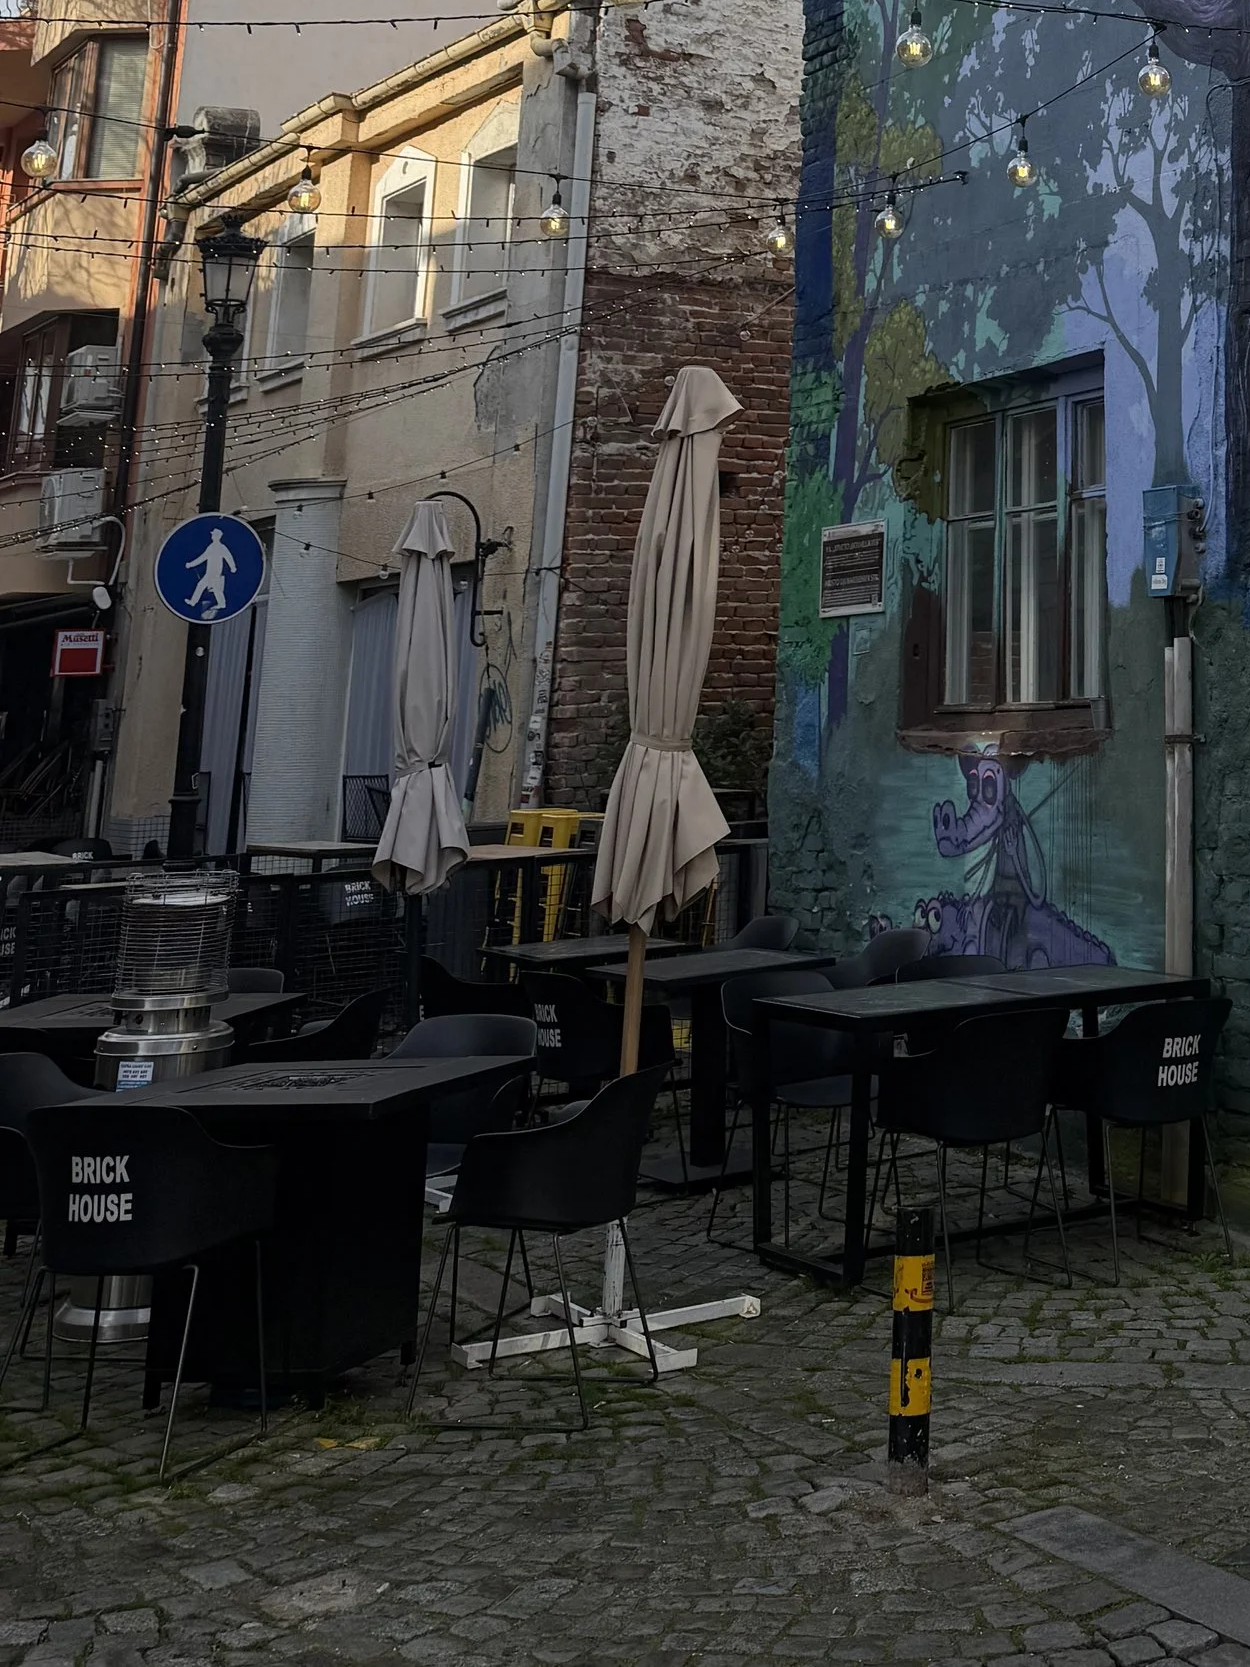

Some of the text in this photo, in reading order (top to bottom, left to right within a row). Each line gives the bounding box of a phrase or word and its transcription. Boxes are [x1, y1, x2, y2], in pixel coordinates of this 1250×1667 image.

[62, 633, 99, 643] Musetti
[1162, 1034, 1201, 1059] BRICK
[1157, 1061, 1200, 1087] HOUSE
[71, 1155, 130, 1184] BRICK
[68, 1192, 133, 1223] HOUSE
